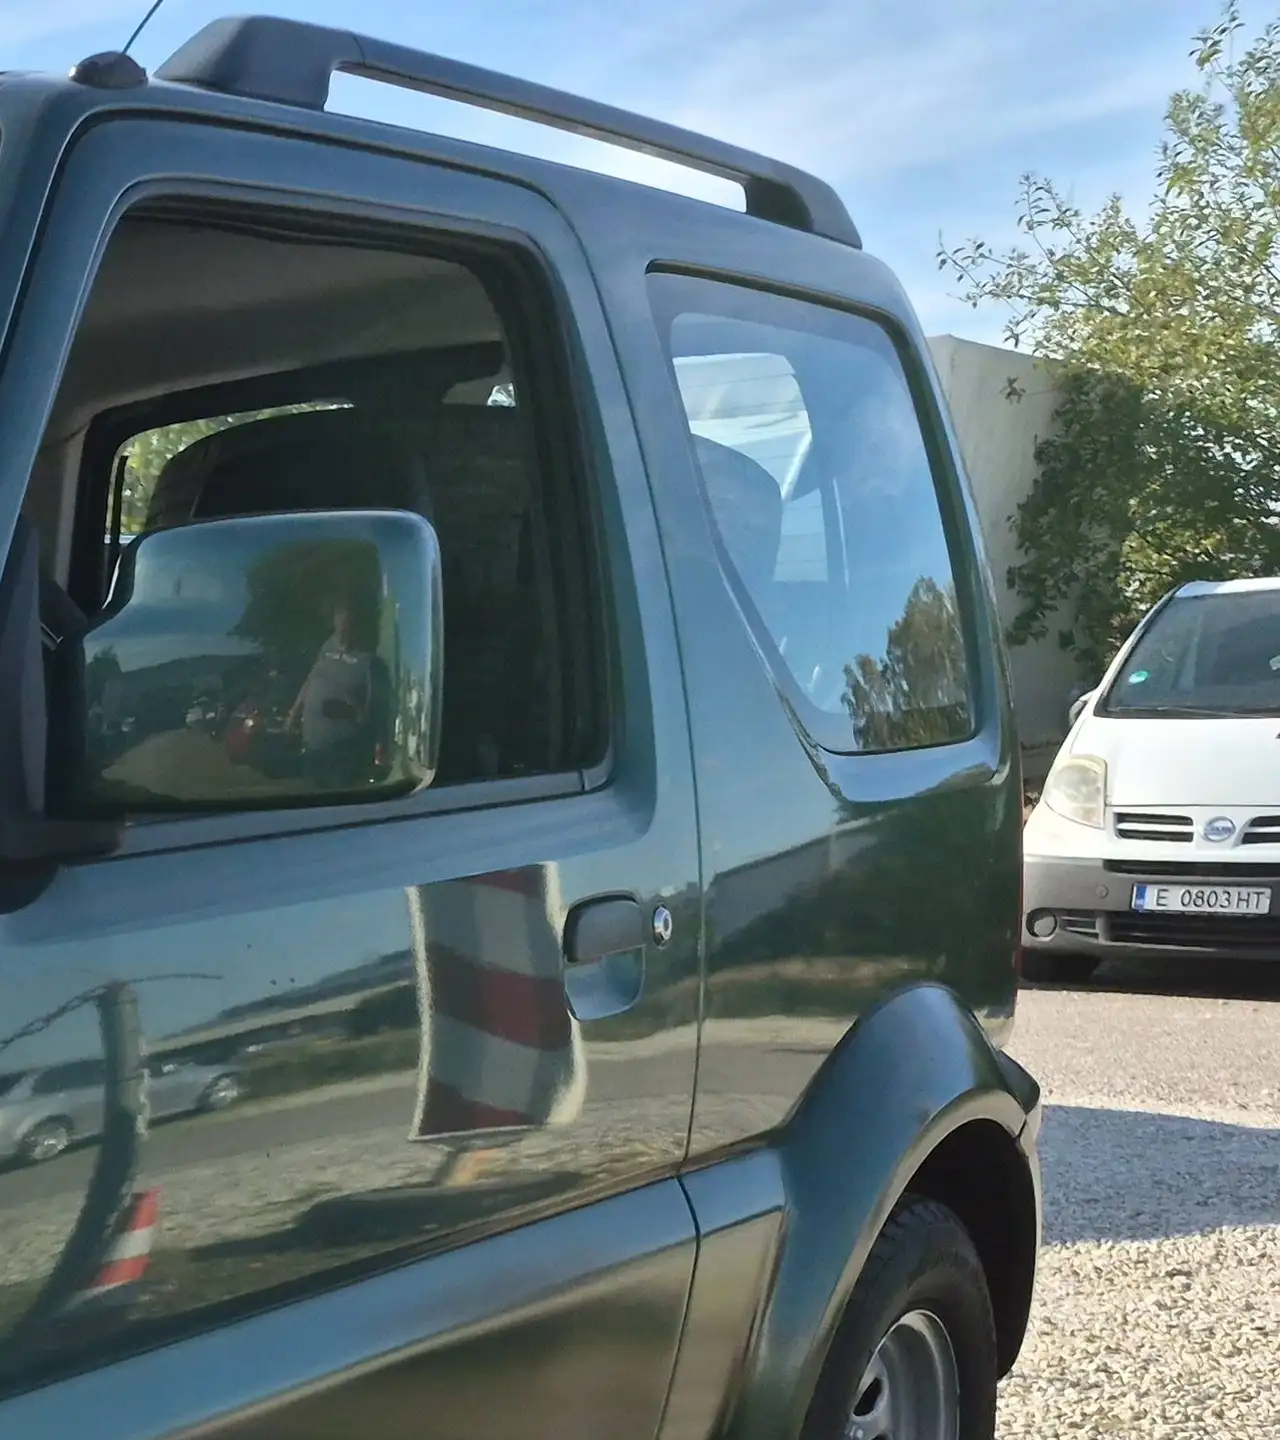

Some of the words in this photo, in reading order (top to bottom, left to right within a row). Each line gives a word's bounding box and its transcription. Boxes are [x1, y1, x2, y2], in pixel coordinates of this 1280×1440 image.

[1155, 887, 1169, 907] E
[1180, 888, 1232, 909] 0803
[1236, 890, 1266, 910] HT
